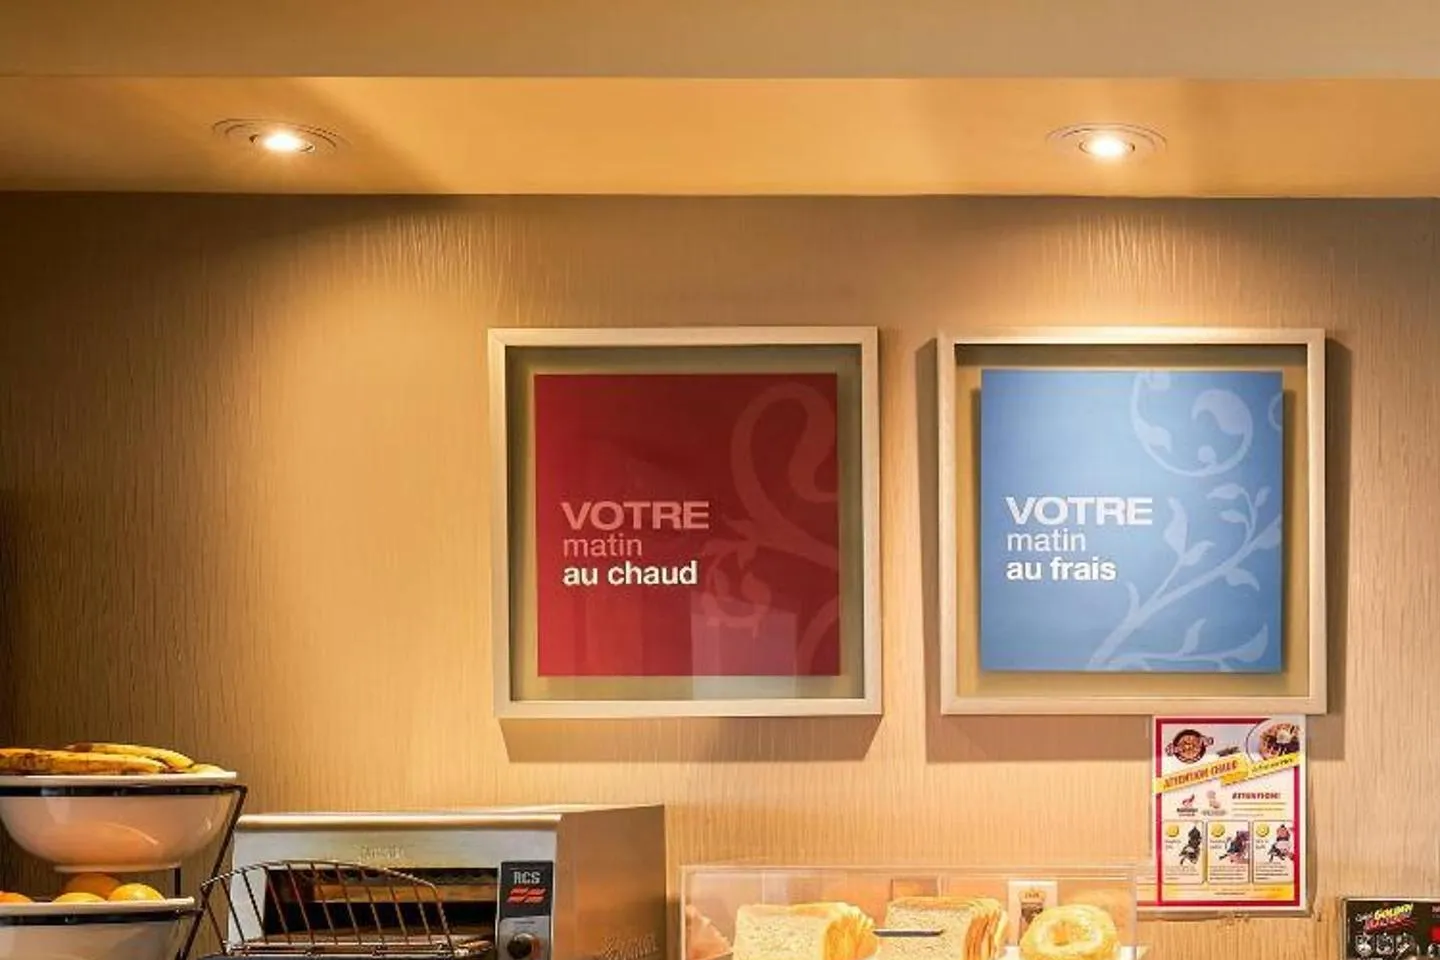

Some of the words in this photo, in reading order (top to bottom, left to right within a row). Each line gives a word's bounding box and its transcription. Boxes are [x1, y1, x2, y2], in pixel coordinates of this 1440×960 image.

[561, 501, 709, 530] VOTRE
[1006, 496, 1153, 526] VOTRE
[563, 533, 643, 557] matin
[1007, 529, 1087, 552] matin
[563, 566, 598, 586] au
[608, 560, 698, 586] chaud
[1006, 561, 1042, 581] au
[1050, 556, 1117, 581] frais
